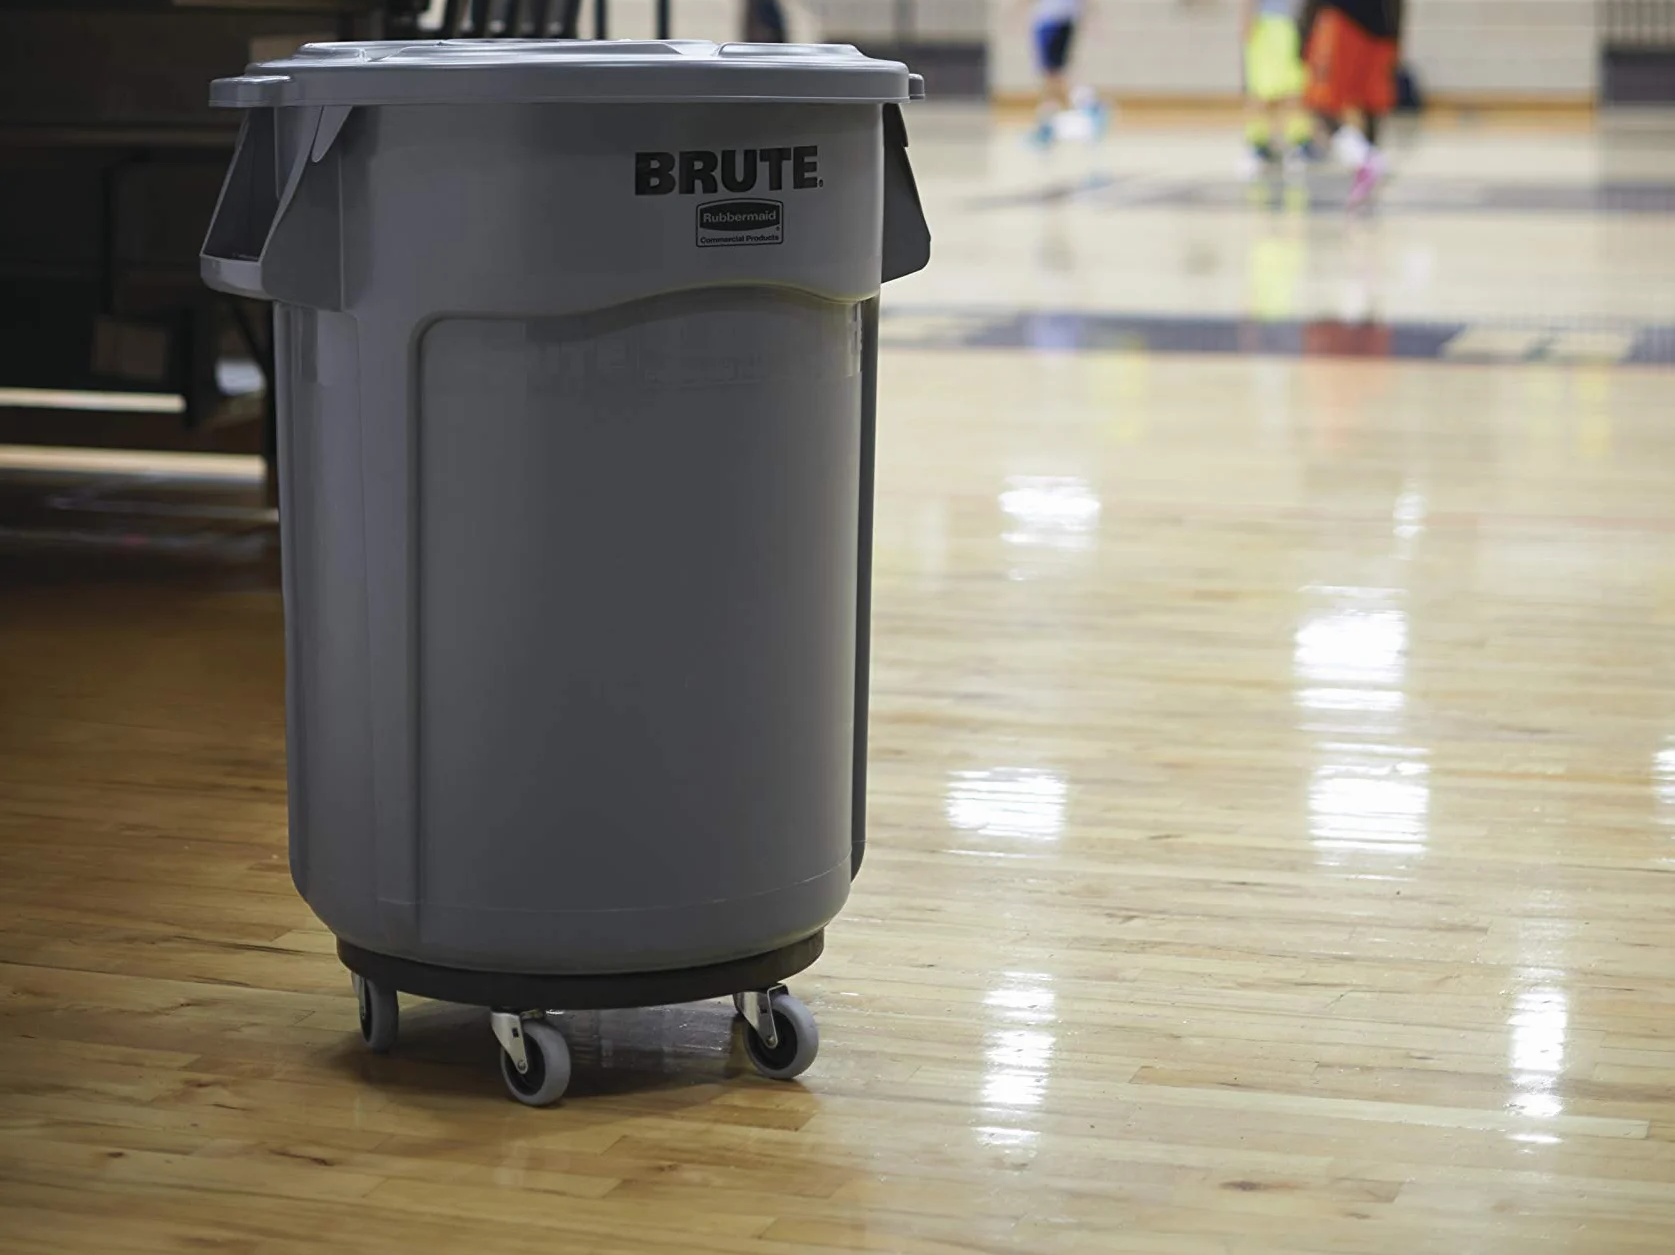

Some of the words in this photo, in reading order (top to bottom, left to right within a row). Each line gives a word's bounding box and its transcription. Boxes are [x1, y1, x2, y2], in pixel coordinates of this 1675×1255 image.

[703, 209, 776, 223] Rubbermaid
[700, 234, 745, 244] Commercial
[746, 233, 779, 242] Products
